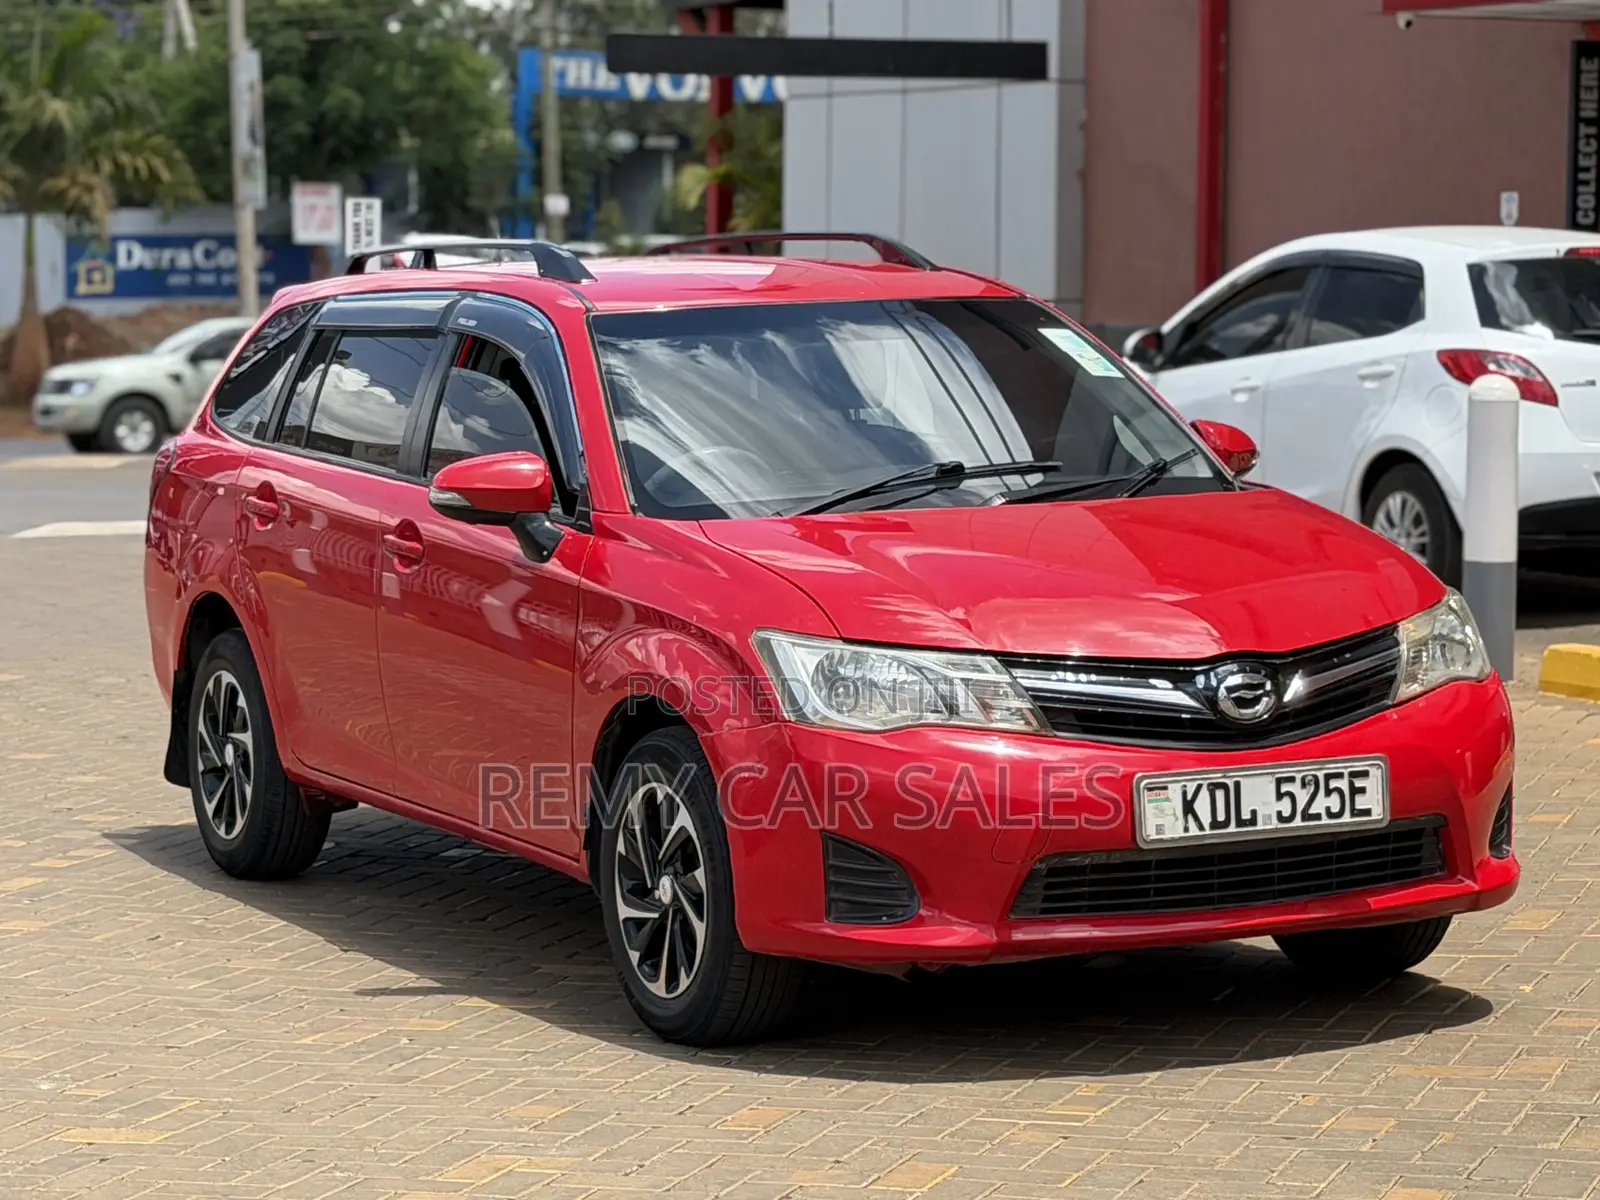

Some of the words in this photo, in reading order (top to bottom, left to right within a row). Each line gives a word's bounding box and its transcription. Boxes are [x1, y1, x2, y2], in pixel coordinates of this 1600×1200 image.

[1578, 56, 1600, 118] HERE
[1575, 122, 1598, 226] COLLECT
[1180, 779, 1258, 834] KDL
[1274, 769, 1374, 825] 525E
